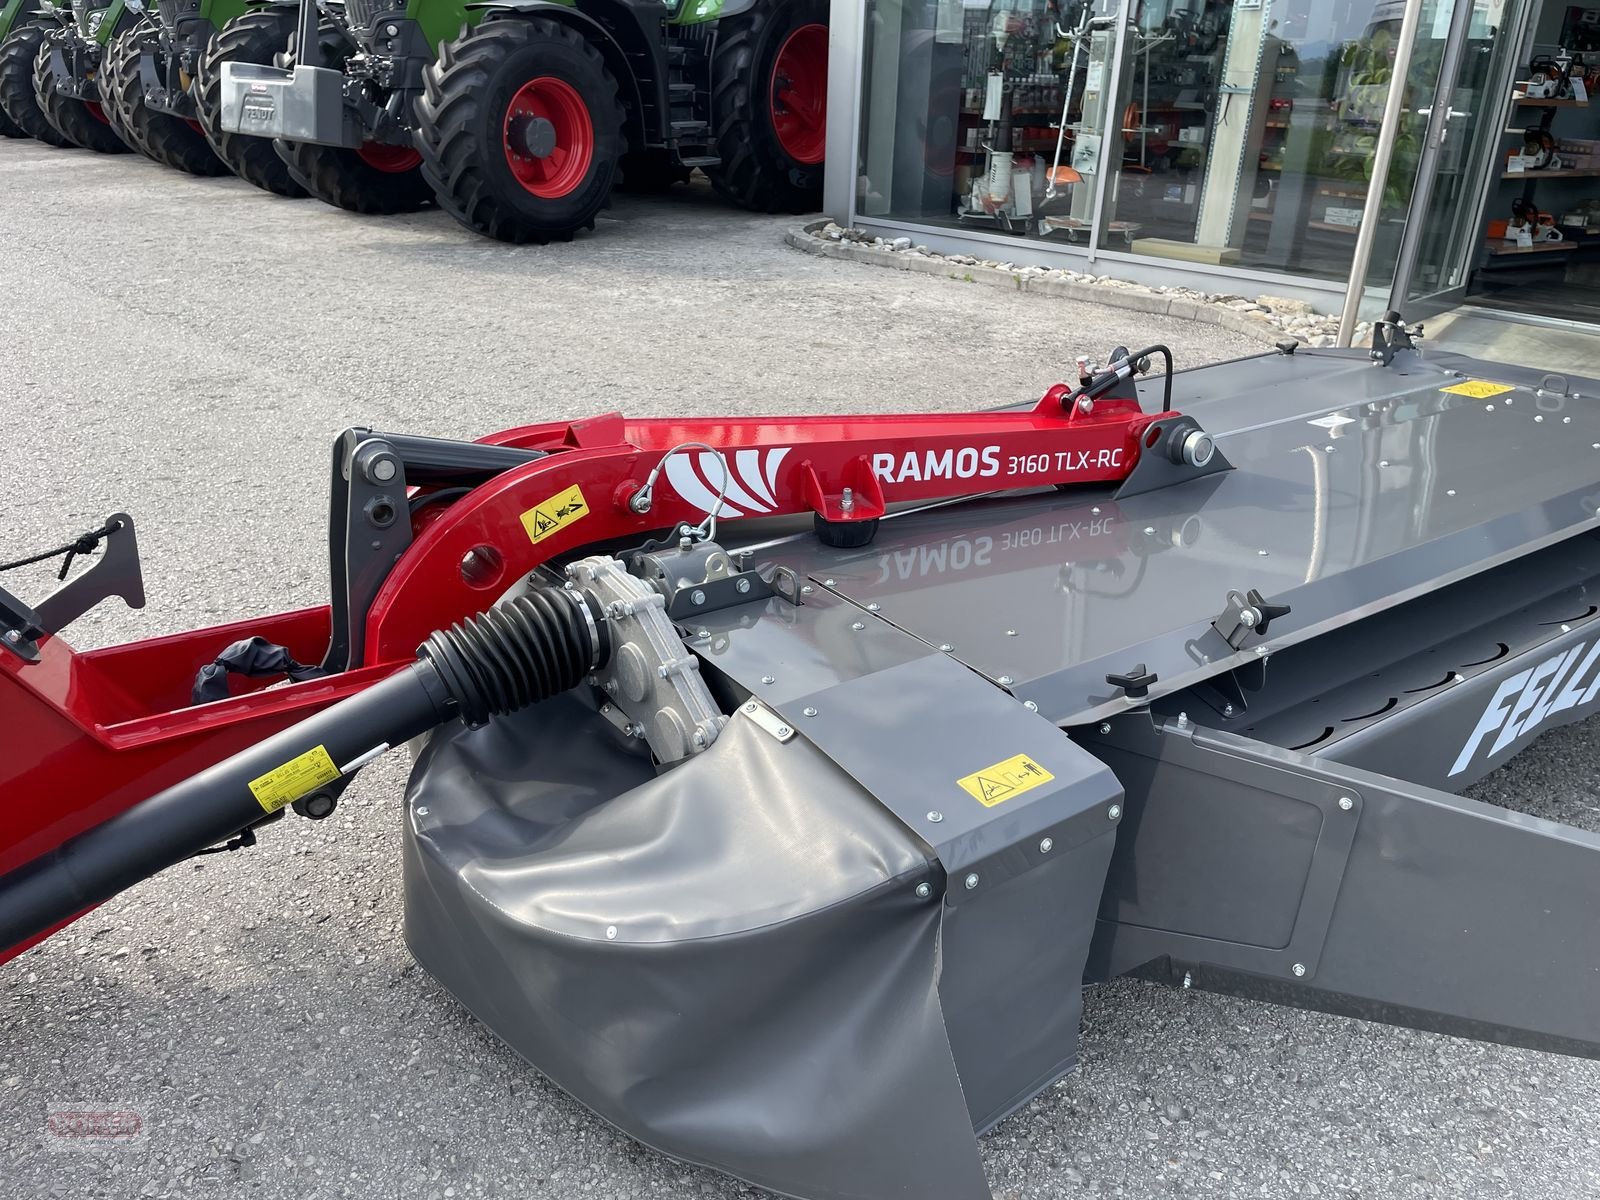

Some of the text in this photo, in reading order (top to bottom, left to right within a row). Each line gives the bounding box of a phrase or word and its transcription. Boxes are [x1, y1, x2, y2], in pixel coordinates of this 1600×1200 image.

[872, 445, 1123, 483] RAMOS 3160 TLX-RC
